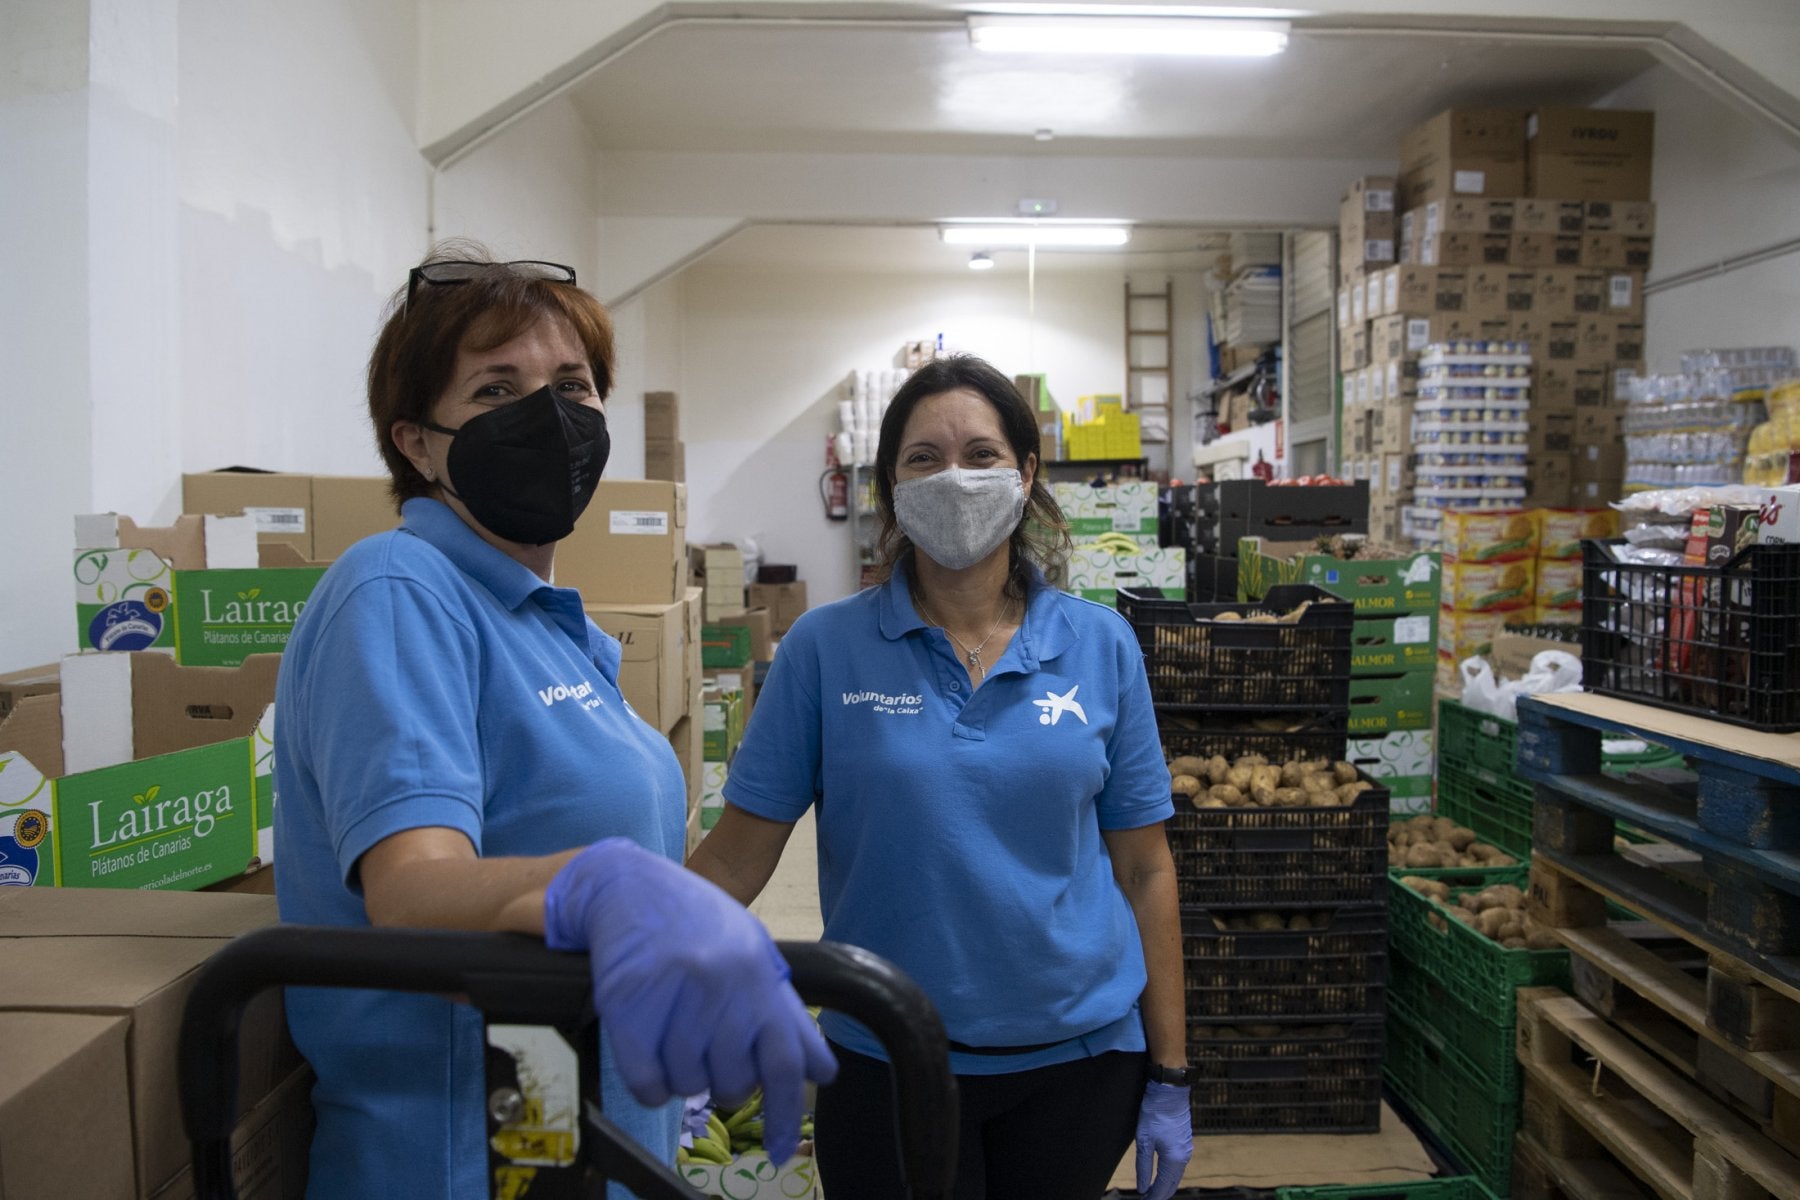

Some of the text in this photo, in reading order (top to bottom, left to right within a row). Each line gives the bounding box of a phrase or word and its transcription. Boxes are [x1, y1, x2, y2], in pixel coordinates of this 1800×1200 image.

[204, 631, 240, 644] Plátanos
[241, 631, 253, 644] de
[842, 690, 923, 705] Voluntarios
[88, 785, 234, 849] Lairaga
[91, 836, 192, 878] Plátanos de Canarias
[0, 869, 21, 880] narias
